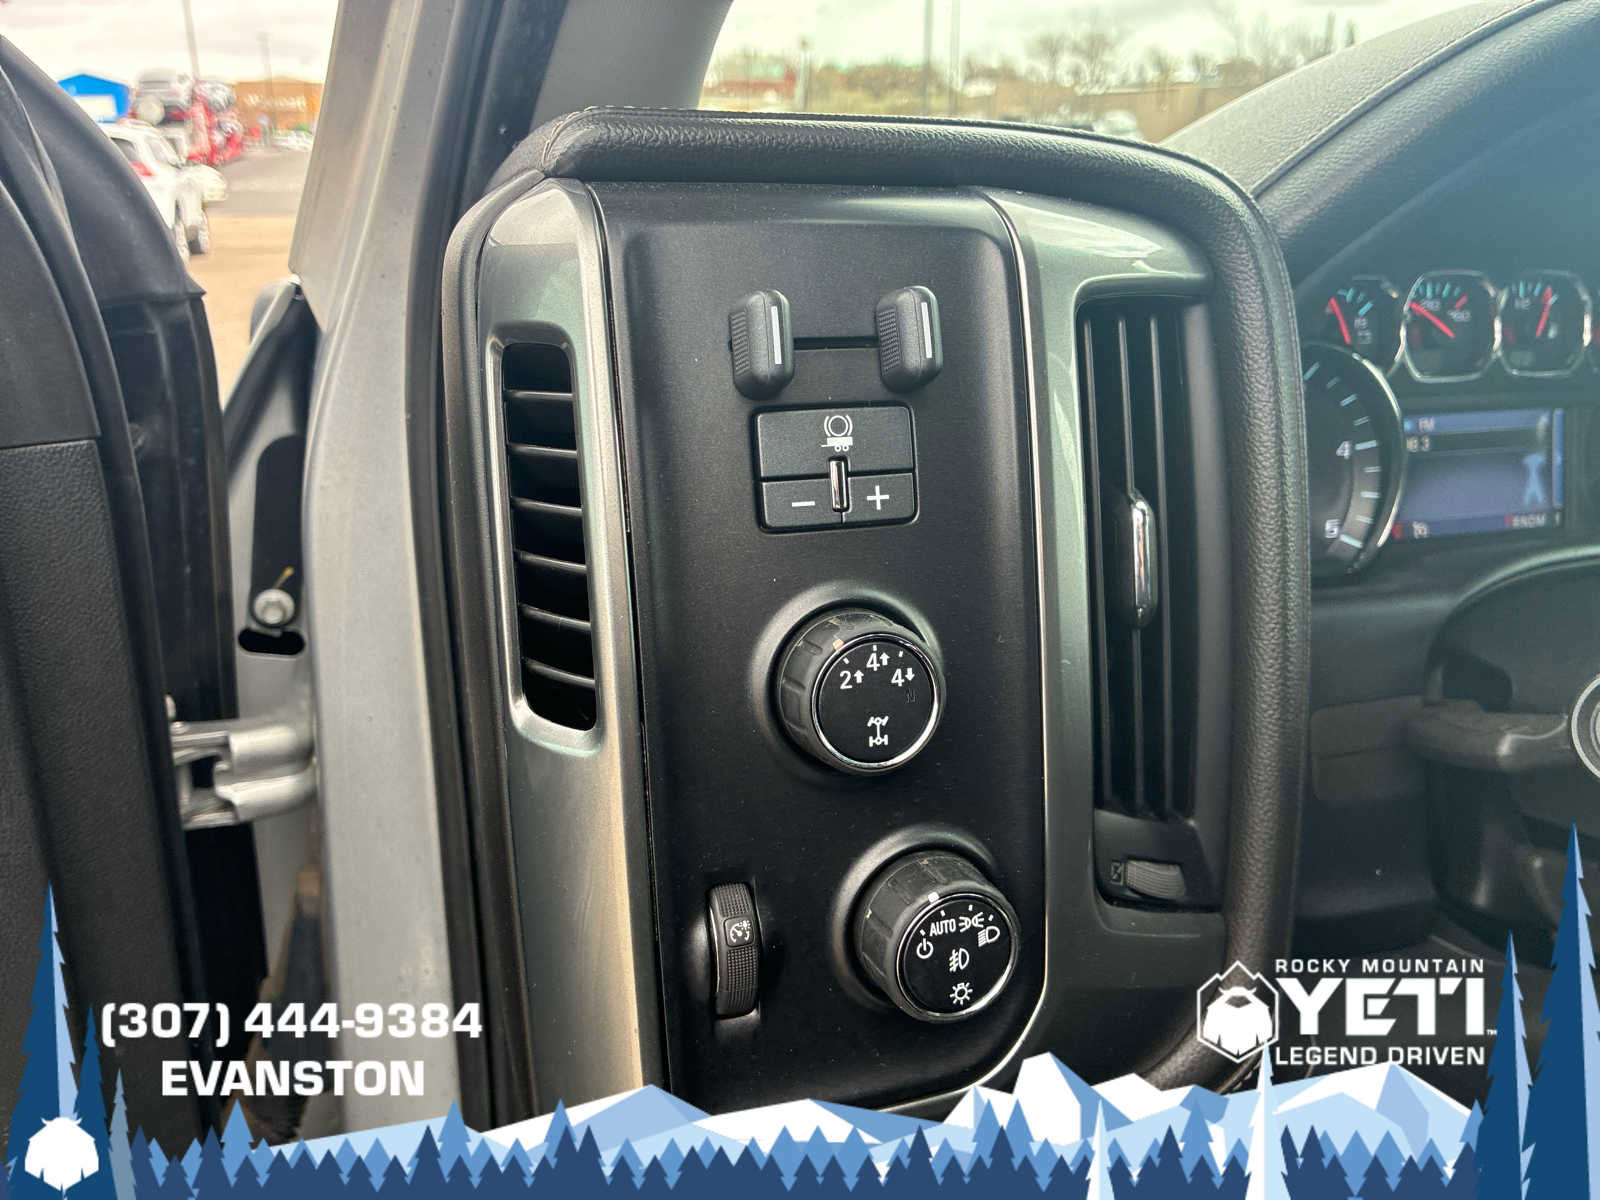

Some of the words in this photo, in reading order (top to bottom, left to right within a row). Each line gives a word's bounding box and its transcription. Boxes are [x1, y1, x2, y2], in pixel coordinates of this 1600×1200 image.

[1335, 440, 1351, 460] 4
[866, 652, 880, 671] 4
[839, 670, 852, 690] 2
[890, 668, 905, 687] 4
[929, 918, 957, 937] AUTO
